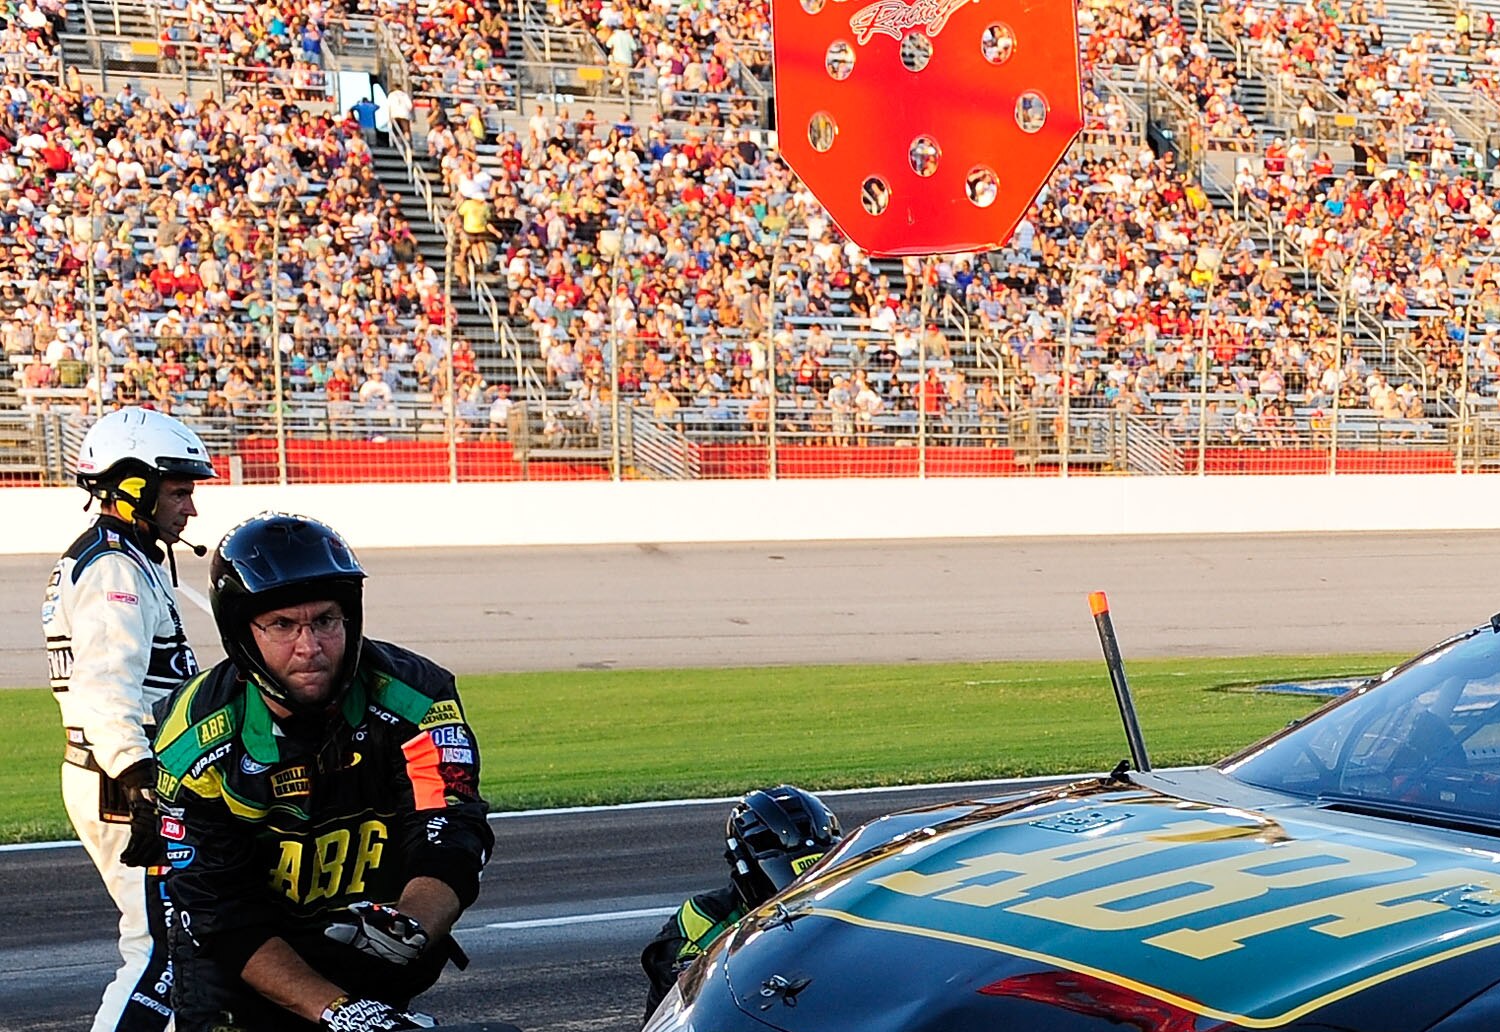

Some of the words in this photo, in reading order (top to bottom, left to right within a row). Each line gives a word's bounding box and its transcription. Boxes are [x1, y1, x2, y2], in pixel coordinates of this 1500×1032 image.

[201, 713, 226, 744] ABF
[269, 819, 388, 906] ABF
[131, 991, 172, 1017] SERIES
